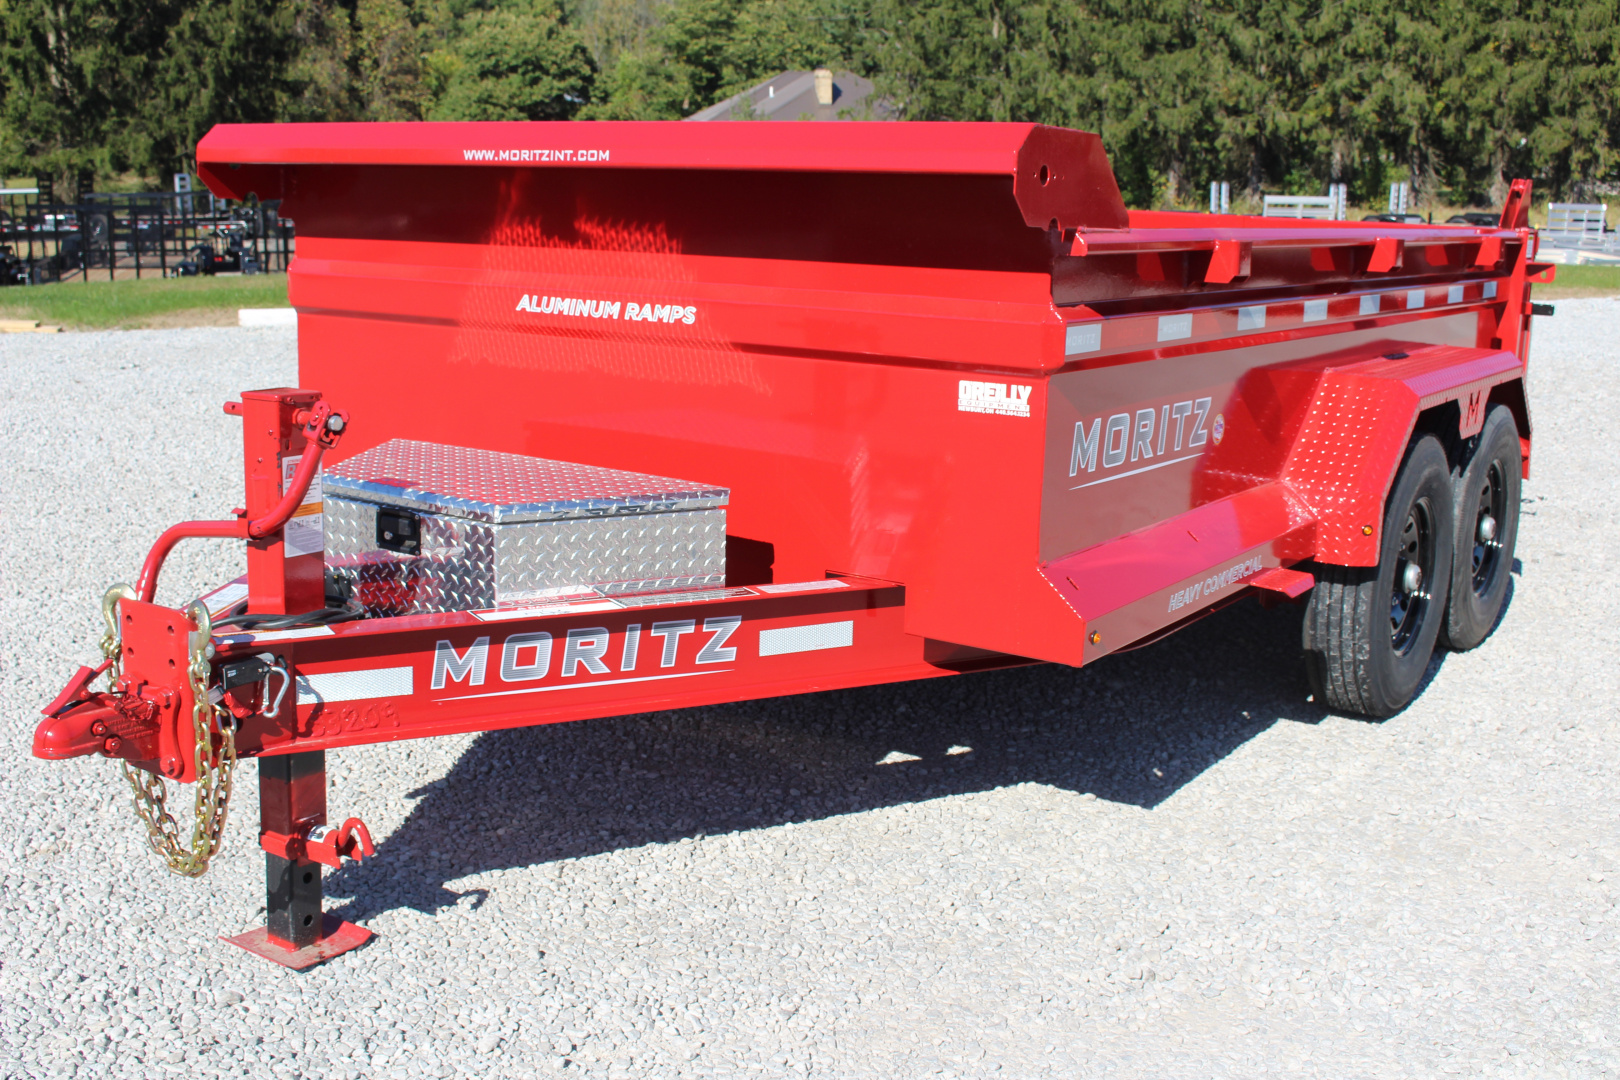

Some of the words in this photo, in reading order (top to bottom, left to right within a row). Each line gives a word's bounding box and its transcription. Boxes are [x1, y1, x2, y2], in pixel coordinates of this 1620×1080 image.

[463, 149, 610, 162] WWW.MORITZINT.COM
[516, 294, 621, 320] ALUMINUM
[624, 302, 697, 325] RAMPS
[958, 399, 1029, 411] EQUIPMENT
[1068, 396, 1213, 478] MORITZ
[1167, 581, 1204, 613] HEAVY
[1203, 554, 1263, 596] COMMERCIAL
[430, 615, 742, 690] MORITZ
